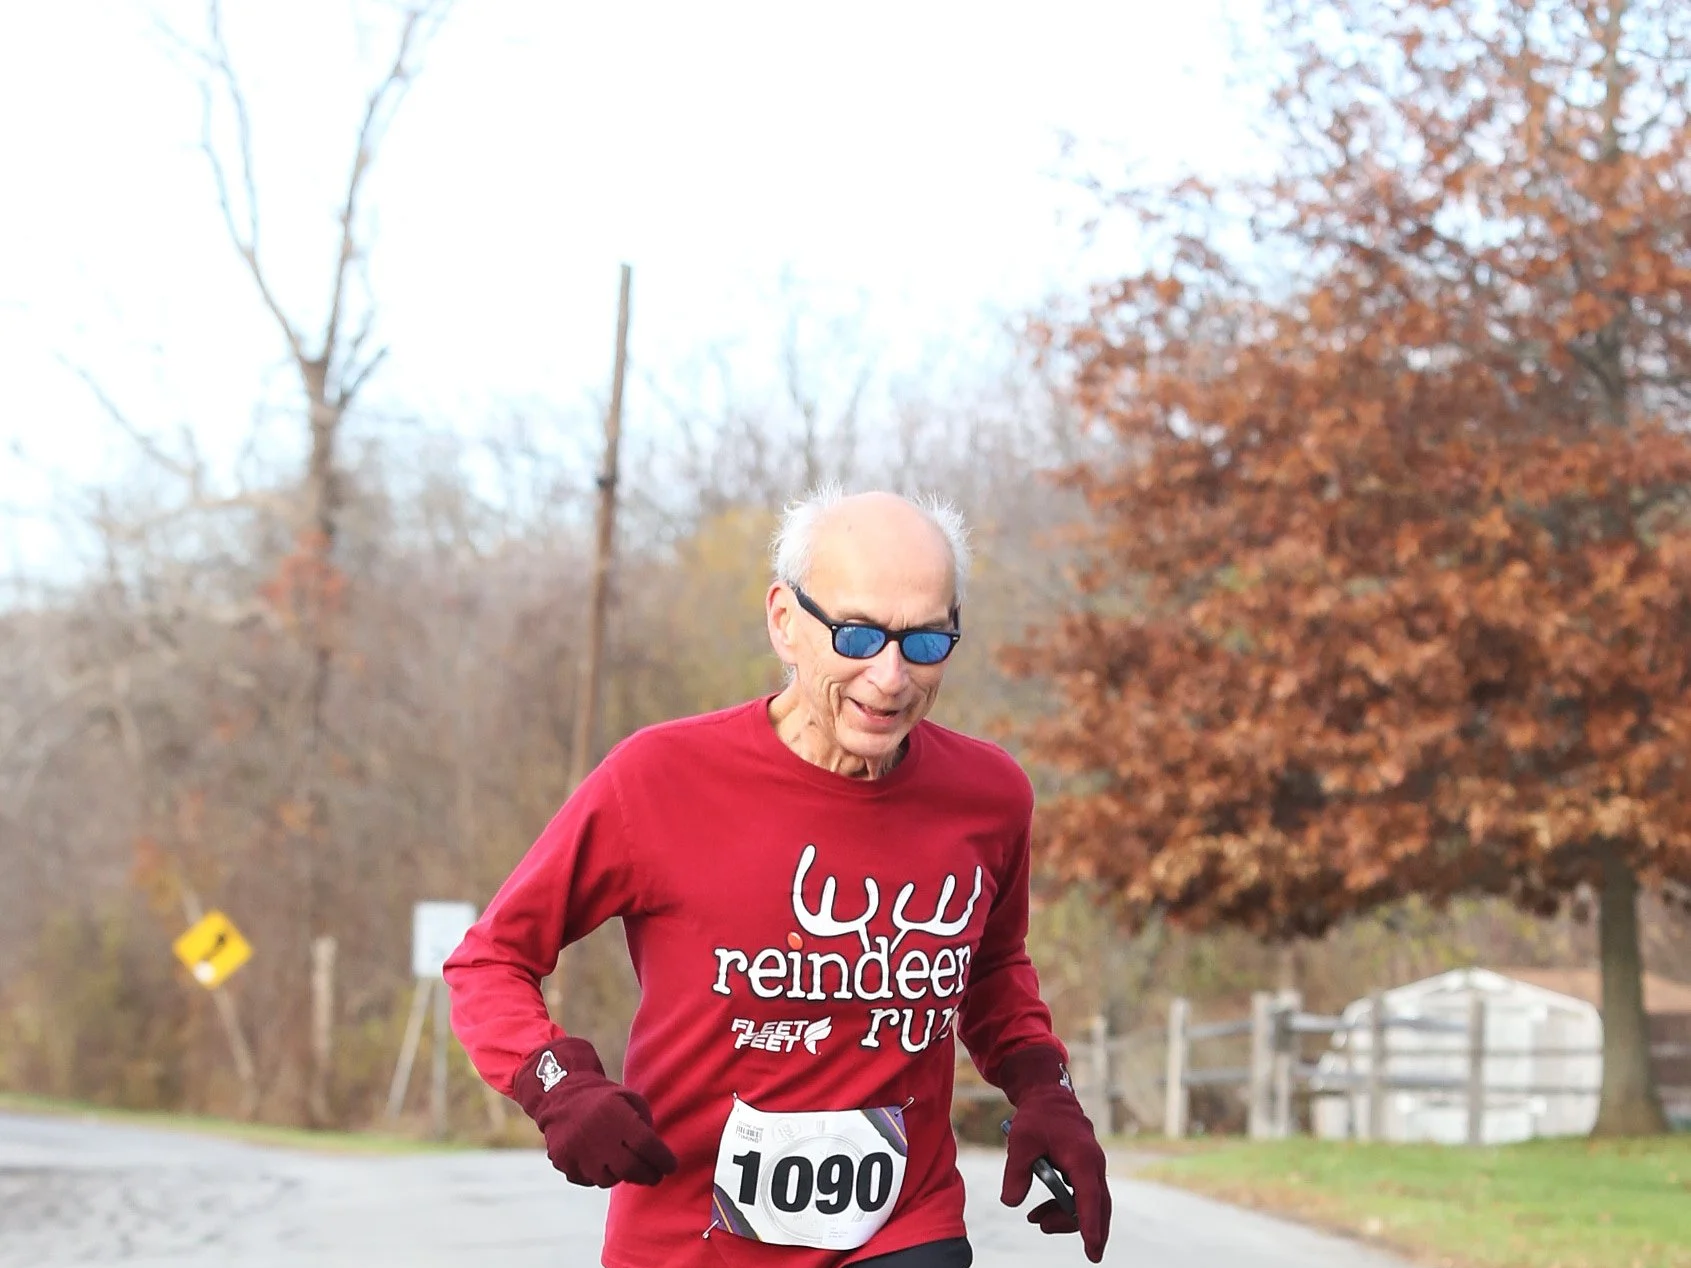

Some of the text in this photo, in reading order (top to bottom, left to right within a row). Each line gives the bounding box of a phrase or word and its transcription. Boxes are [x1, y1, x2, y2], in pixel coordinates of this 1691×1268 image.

[712, 932, 970, 1000] reindeer
[731, 1018, 809, 1036] FLEET
[734, 1032, 801, 1053] FEET
[732, 1150, 894, 1215] 1090
